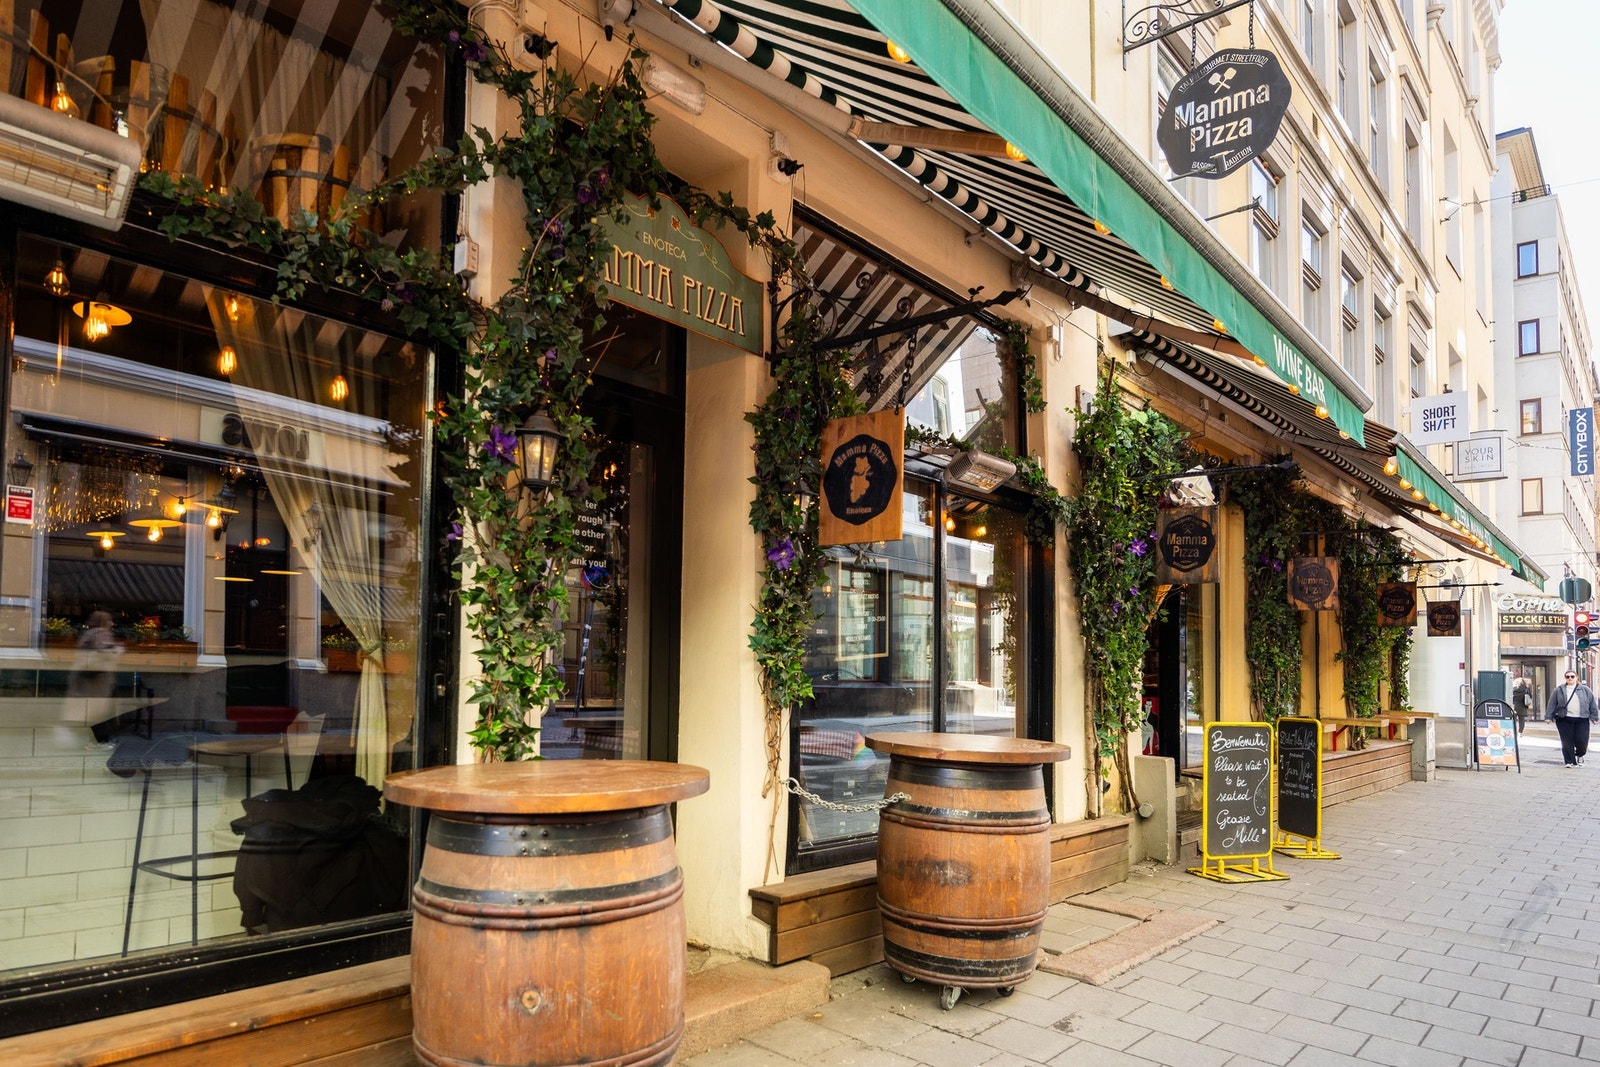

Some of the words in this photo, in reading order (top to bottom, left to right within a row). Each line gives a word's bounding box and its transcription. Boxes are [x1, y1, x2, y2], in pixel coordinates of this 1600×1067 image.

[1174, 84, 1270, 131] Mamma
[1190, 117, 1253, 152] Pizza
[642, 232, 687, 262] ENOTECA
[682, 274, 745, 336] PIZZA
[1273, 334, 1303, 389] WINE
[1305, 364, 1327, 405] BAR
[1423, 405, 1456, 421] SHORT
[1576, 411, 1588, 474] CITYBOX
[834, 445, 867, 467] Mamma
[869, 443, 889, 465] Pizza
[1465, 447, 1494, 456] YOUR
[1465, 454, 1494, 463] SKIN
[581, 529, 605, 540] other
[1166, 533, 1207, 545] Mamma
[1172, 545, 1199, 557] Pizza
[588, 559, 607, 568] you!
[1502, 615, 1566, 624] STOCKFLETHS
[1214, 755, 1243, 772] Please
[1225, 775, 1233, 787] to
[1236, 775, 1248, 787] be
[1215, 789, 1252, 802] seated
[1216, 809, 1252, 830] Grazie
[1221, 827, 1260, 848] Mille
